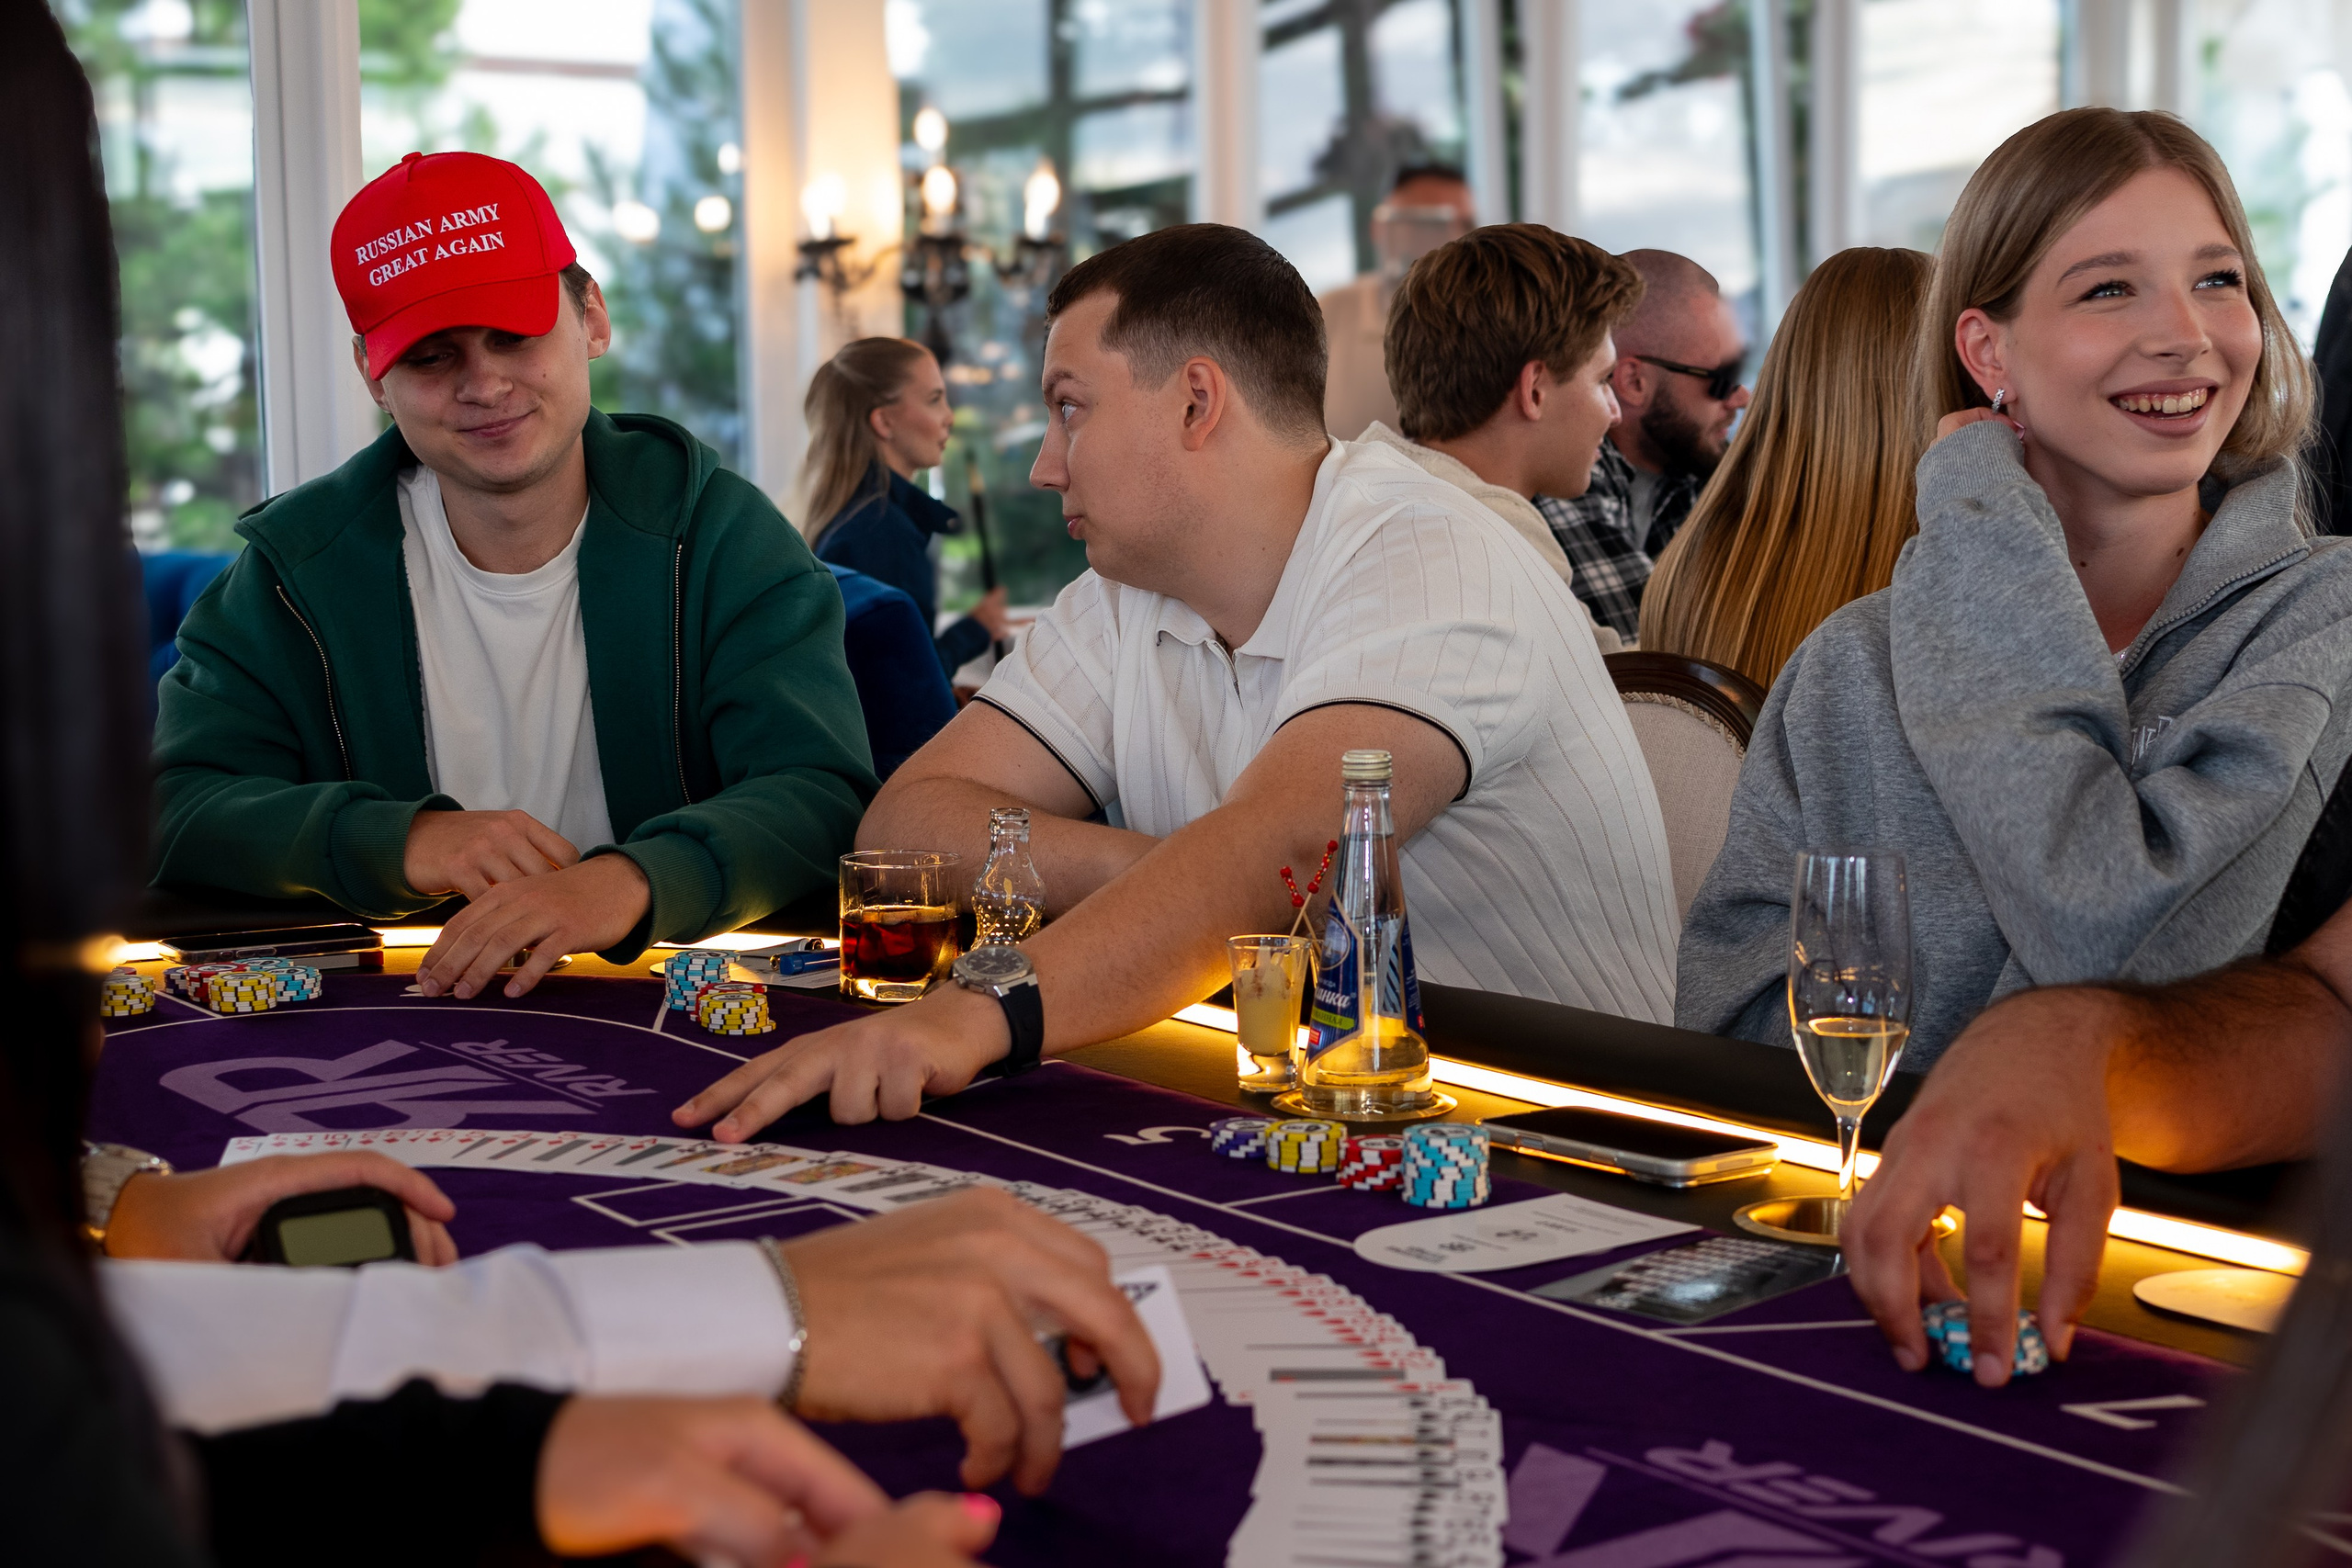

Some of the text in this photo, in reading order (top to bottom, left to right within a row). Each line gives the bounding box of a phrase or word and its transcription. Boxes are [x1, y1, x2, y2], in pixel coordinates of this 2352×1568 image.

[355, 203, 501, 265] RUSSIAN ARMY
[368, 231, 505, 288] GREAT AGAIN
[450, 1038, 660, 1098] RIVER
[322, 1133, 349, 1142] 10
[1103, 1126, 1214, 1145] 5
